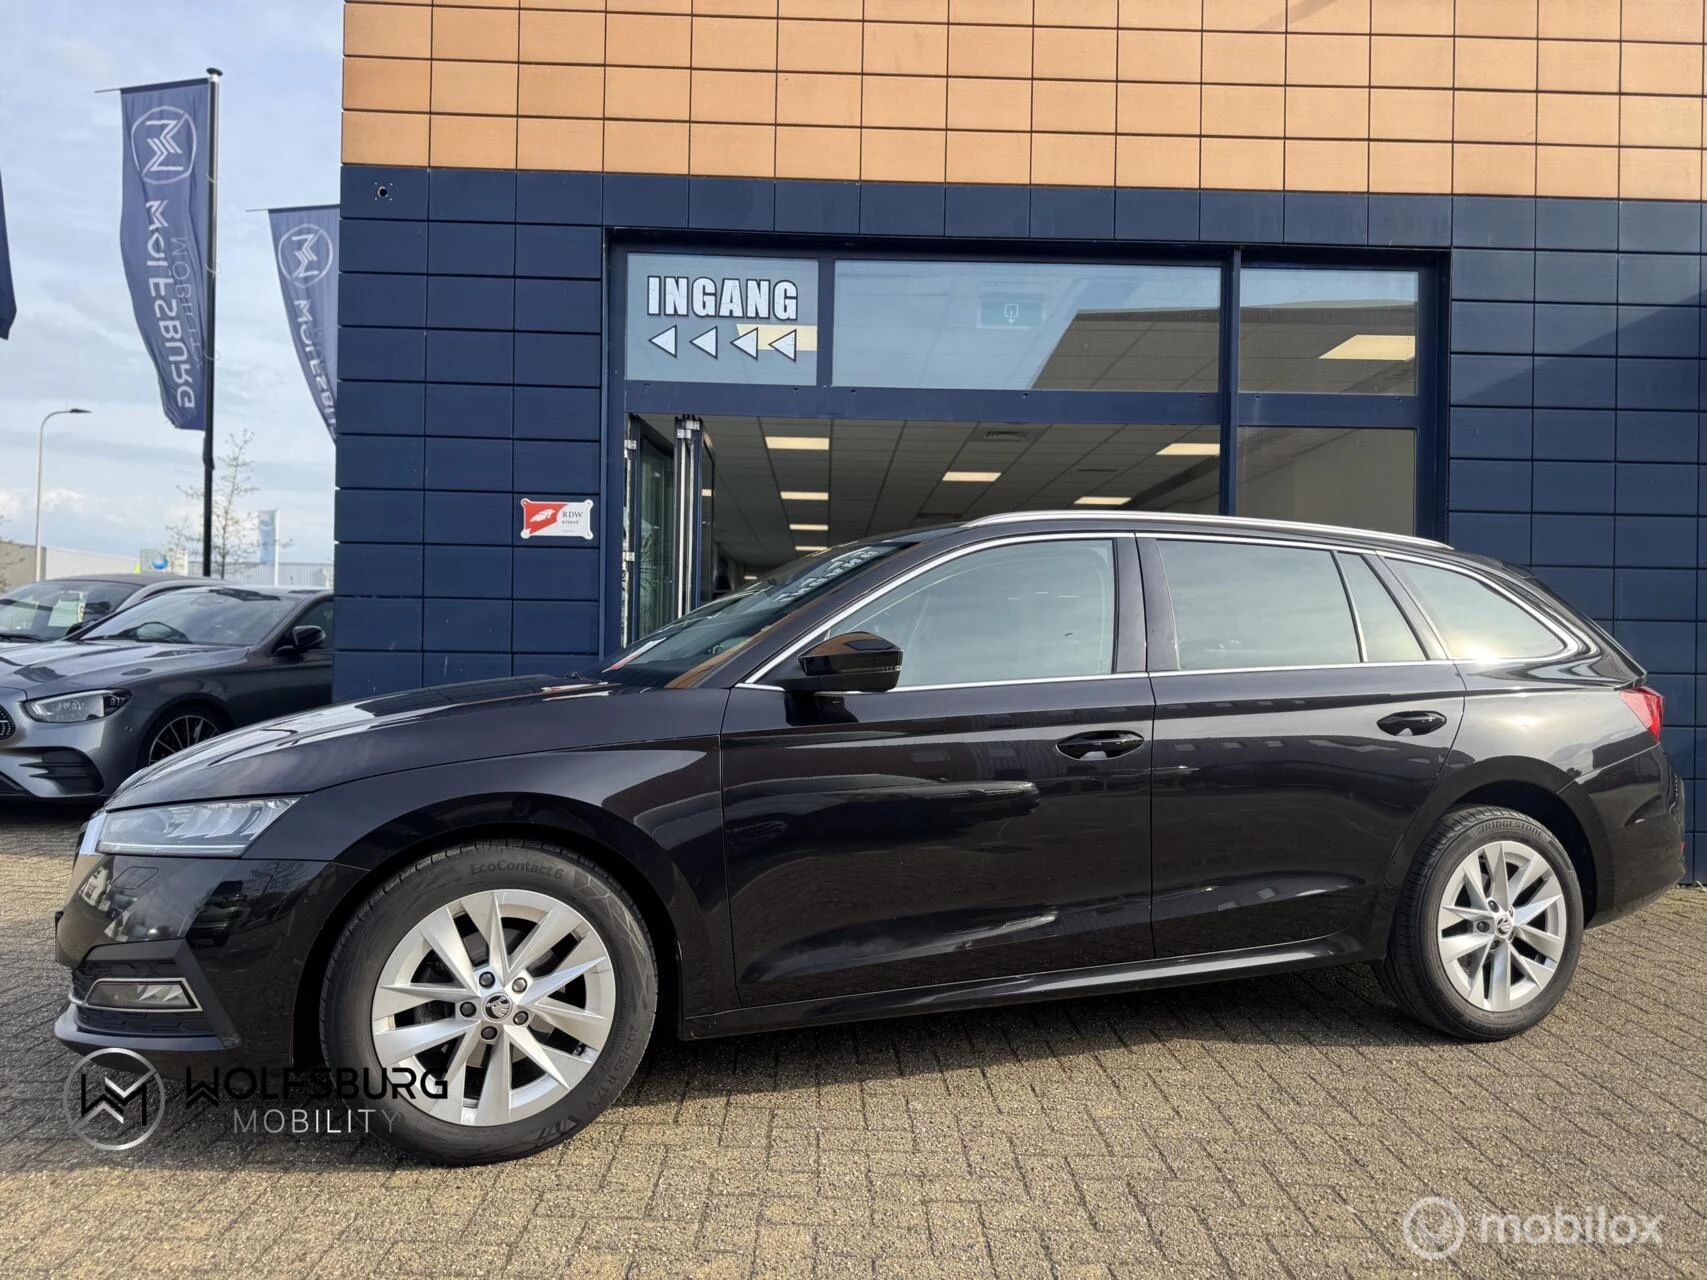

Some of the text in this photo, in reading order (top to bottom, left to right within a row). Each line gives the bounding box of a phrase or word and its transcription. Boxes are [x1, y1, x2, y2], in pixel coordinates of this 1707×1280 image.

[647, 275, 798, 321] INGANG
[470, 859, 564, 879] EcoContact 6
